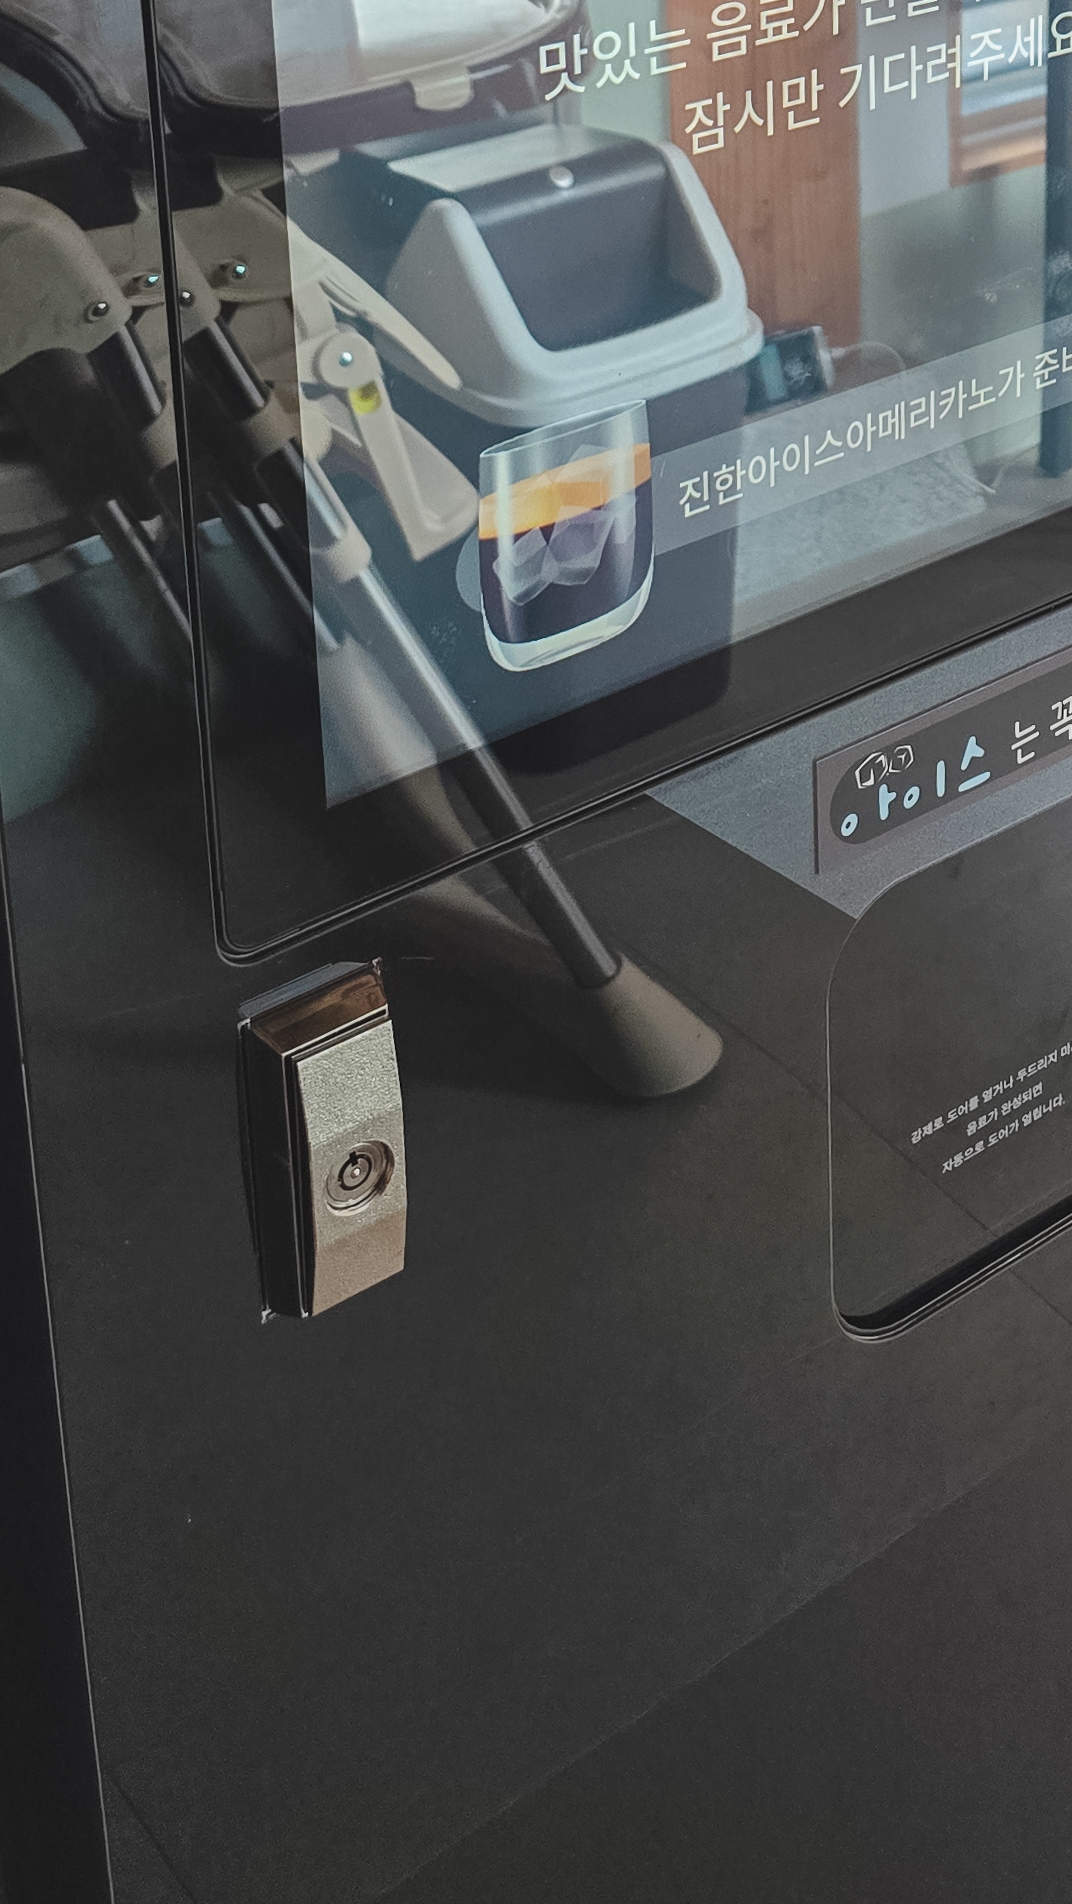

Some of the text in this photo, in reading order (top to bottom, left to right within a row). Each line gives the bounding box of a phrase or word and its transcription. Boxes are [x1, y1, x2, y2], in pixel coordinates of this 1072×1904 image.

[538, 19, 691, 101] 맛있는
[684, 75, 824, 156] 잠시만
[678, 359, 1026, 519] 진한아이스아메리카노가
[840, 735, 991, 837] 아이스
[1010, 720, 1040, 765] 는
[946, 1095, 980, 1124] 도어를
[981, 1075, 1014, 1103] 열거나
[1016, 1049, 1058, 1082] 두드리지
[966, 1082, 1044, 1137] 음료가 완성되면
[941, 1092, 1066, 1175] 자동으로 도어가 열립니다.
